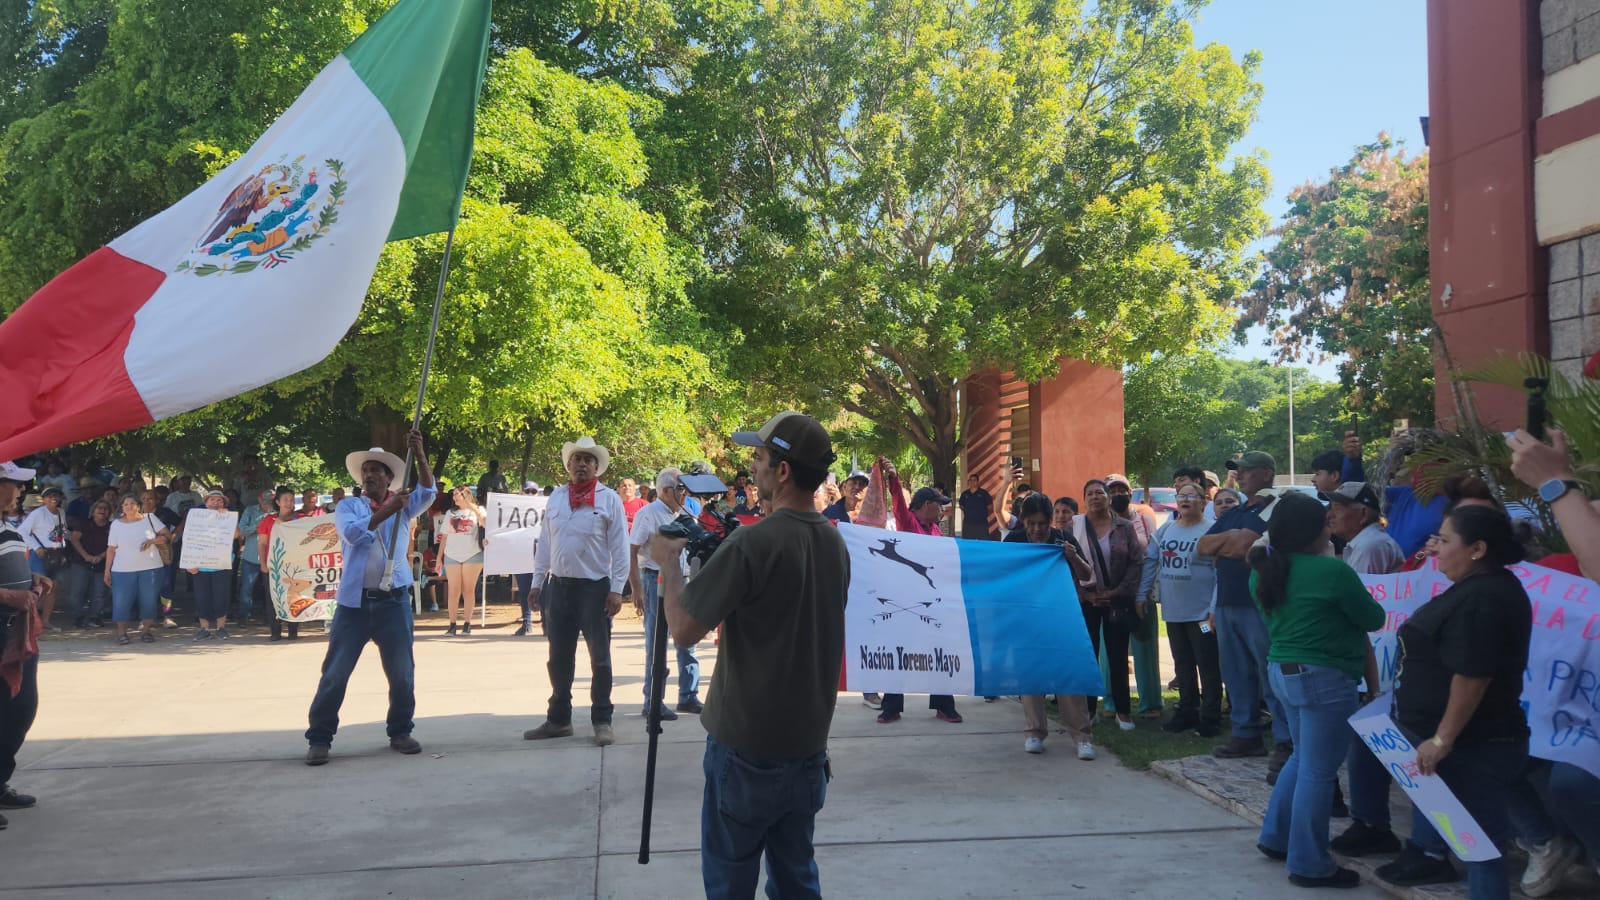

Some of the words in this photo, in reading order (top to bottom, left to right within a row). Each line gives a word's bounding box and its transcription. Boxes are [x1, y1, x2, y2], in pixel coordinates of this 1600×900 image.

[497, 502, 547, 529] ¡AQ
[312, 554, 330, 568] NO
[1162, 556, 1188, 569] NO!
[1394, 577, 1413, 600] LA
[1563, 584, 1590, 604] EL
[860, 645, 894, 670] Nación
[896, 646, 934, 671] Yoreme
[934, 647, 960, 677] Mayo
